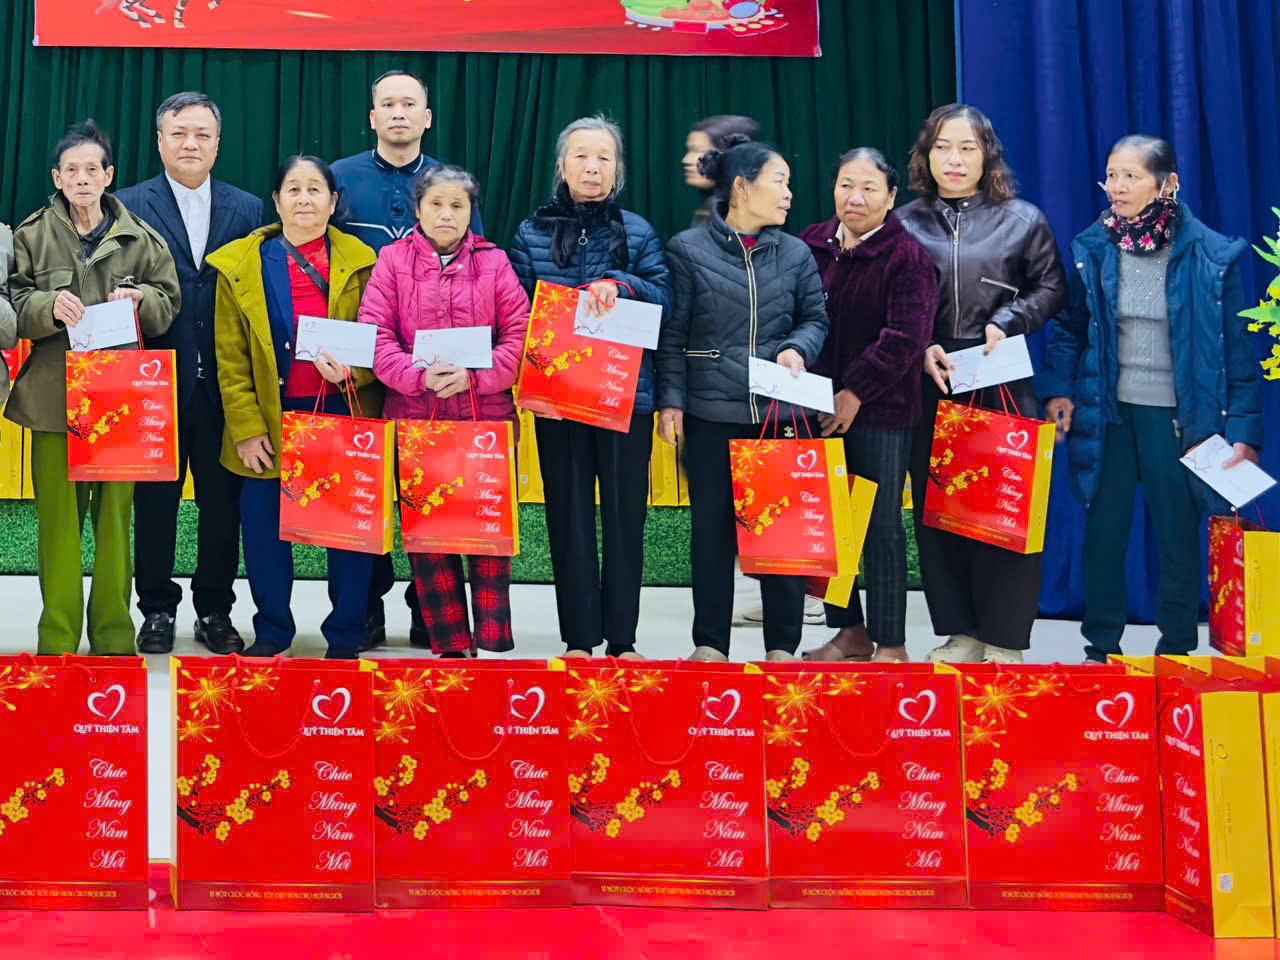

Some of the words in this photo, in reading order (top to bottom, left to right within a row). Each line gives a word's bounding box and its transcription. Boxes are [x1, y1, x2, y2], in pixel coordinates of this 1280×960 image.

[73, 723, 92, 735] QUỸ
[93, 723, 119, 734] THIỆN
[120, 724, 139, 734] TÂM
[319, 727, 345, 736] THIỆN
[346, 727, 365, 736] TÂM
[513, 726, 539, 736] THIỆN
[540, 726, 559, 735] TÂM
[708, 727, 734, 736] THIỆN
[735, 727, 755, 736] TÂM
[905, 727, 929, 738] THIỆN
[930, 727, 951, 736] TÂM
[1084, 730, 1104, 741] QUỸ
[1104, 730, 1130, 741] THIỆN
[1131, 731, 1150, 741] TÂM
